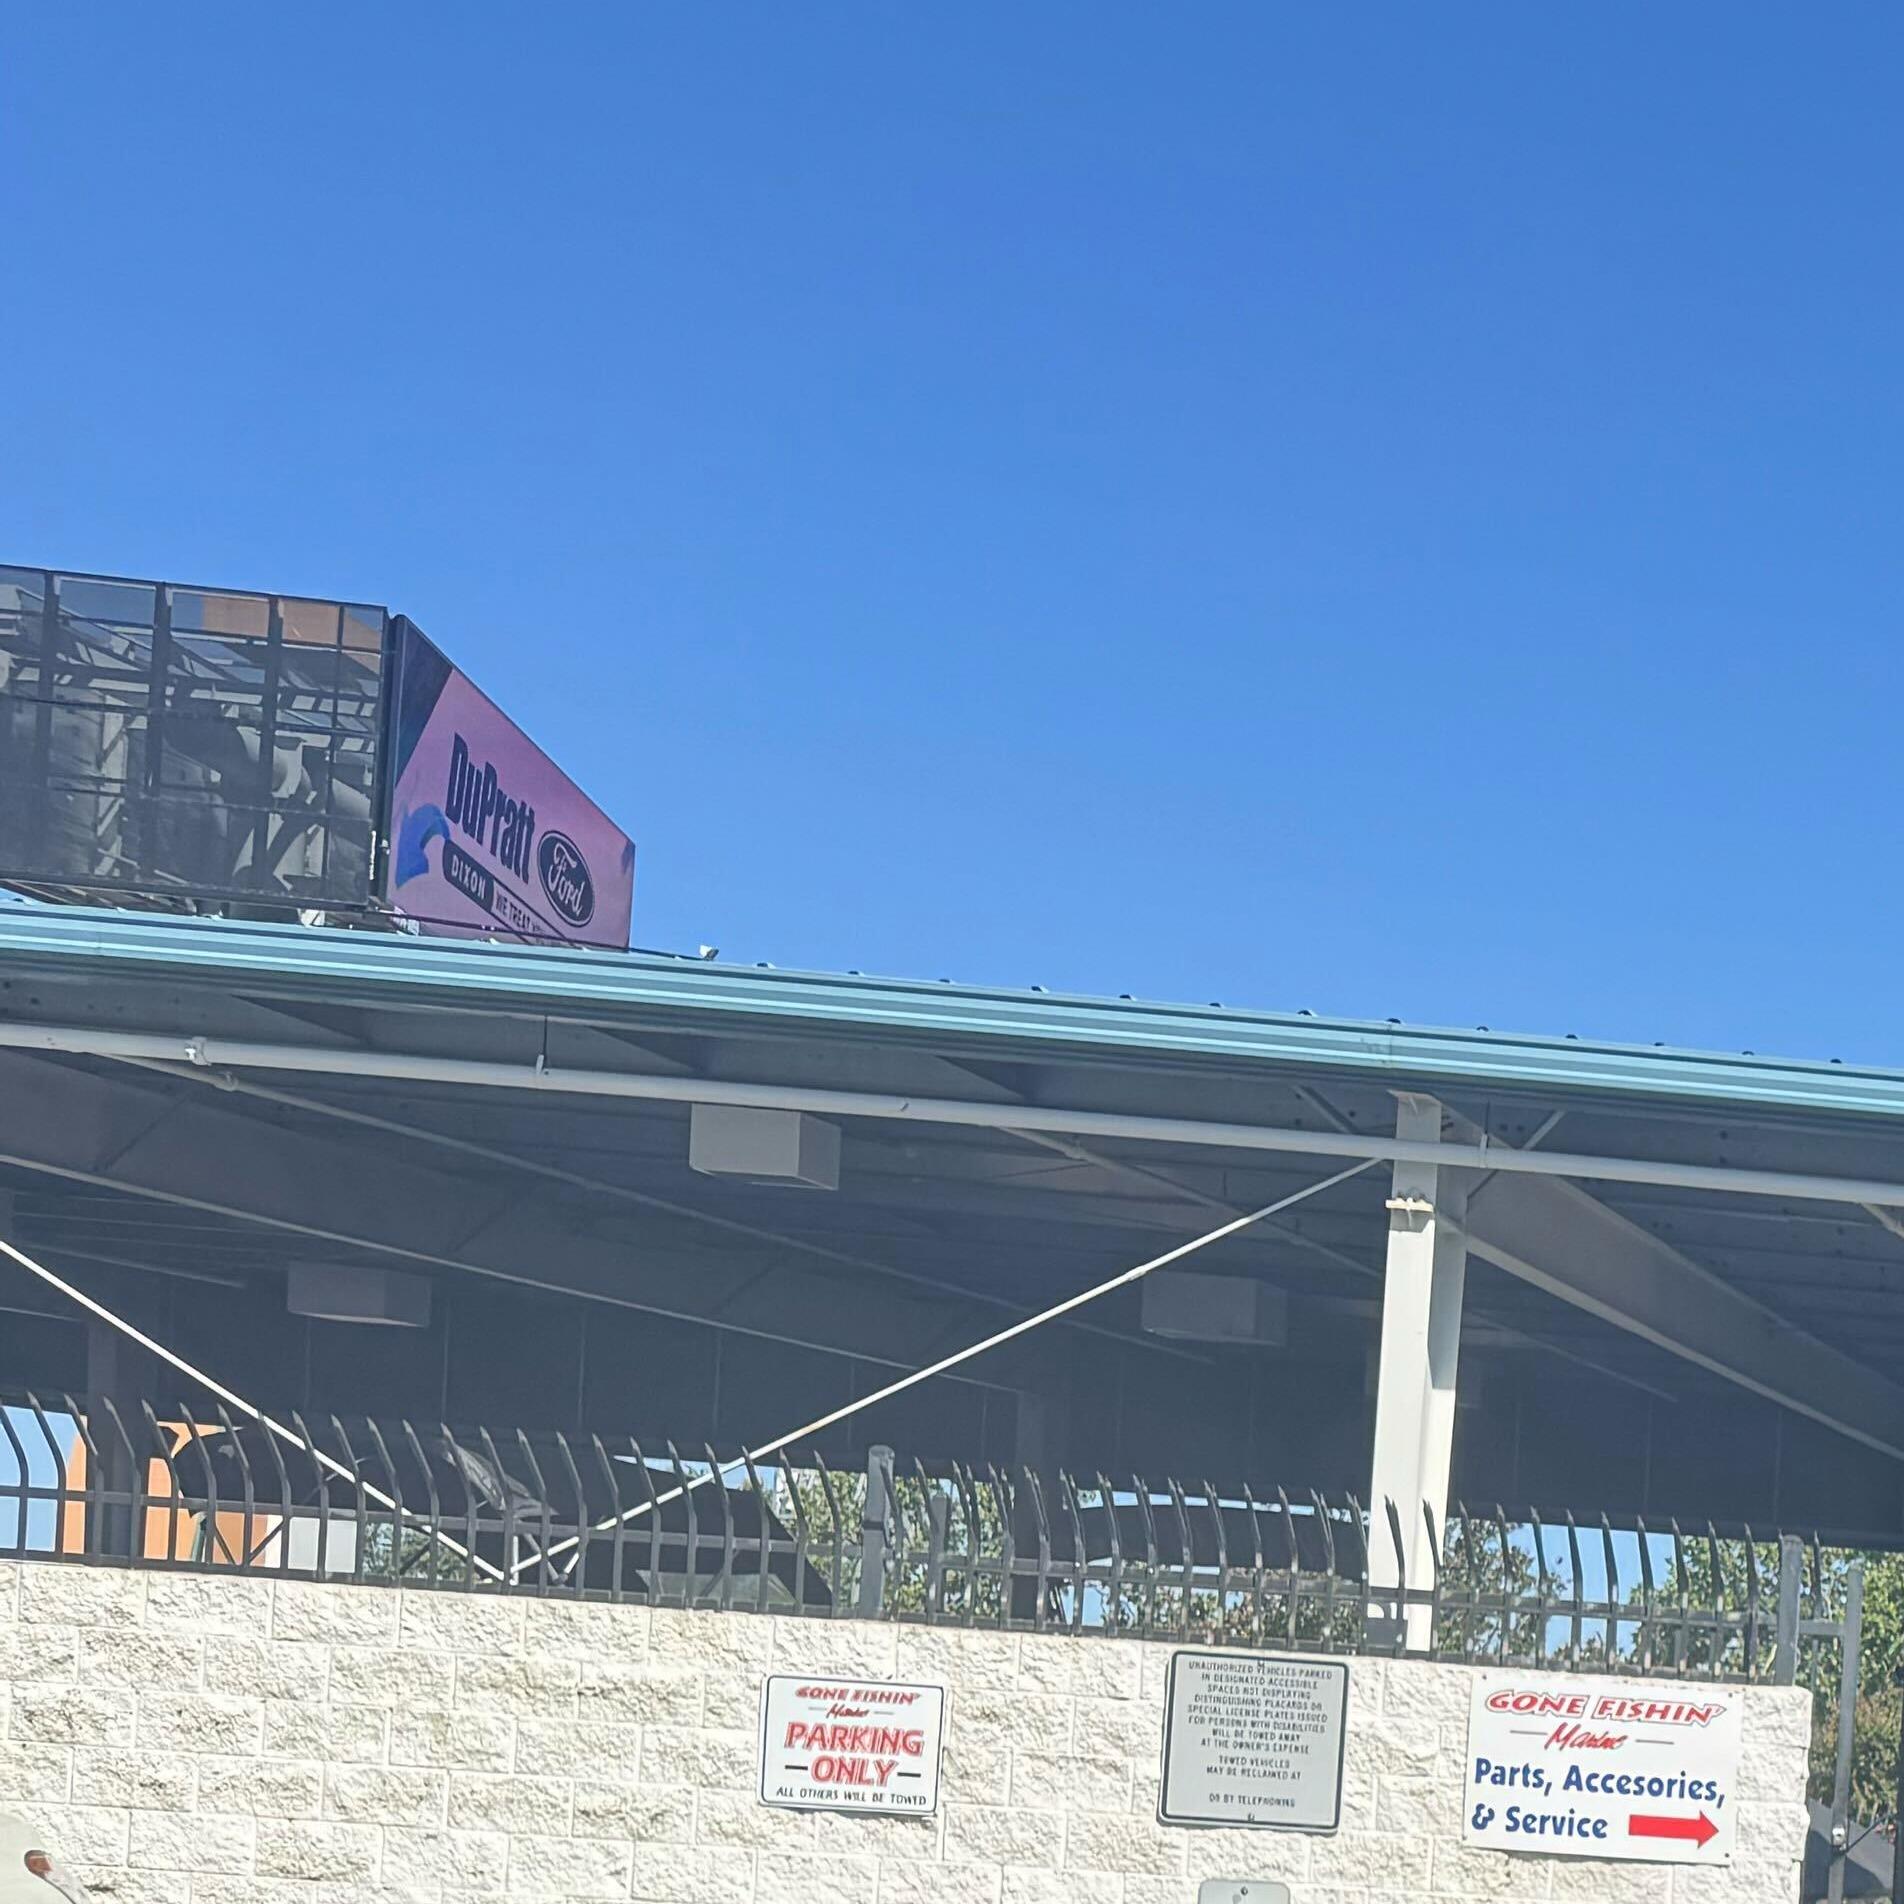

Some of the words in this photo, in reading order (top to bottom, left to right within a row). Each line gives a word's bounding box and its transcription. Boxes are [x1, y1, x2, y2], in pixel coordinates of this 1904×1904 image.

[446, 732, 535, 885] DuPratt
[451, 852, 486, 900] DIXON
[548, 843, 586, 917] Ford
[1189, 1661, 1253, 1673] UNAUTHORIZED
[1256, 1665, 1296, 1677] VEHICLES
[1299, 1668, 1332, 1680] PARKED
[1201, 1673, 1211, 1681] IN
[1214, 1674, 1265, 1685] DESIGNATED
[1268, 1678, 1318, 1690] ACCESSIBLE
[795, 1686, 847, 1701] GONE
[1207, 1684, 1240, 1694] SPACES
[1243, 1686, 1259, 1696] NOT
[1262, 1688, 1311, 1700] DISPLAYING
[1194, 1694, 1261, 1707] DISTINGUISHING
[1265, 1699, 1308, 1711] PLACARDS
[1487, 1690, 1589, 1717] GONE
[1187, 1704, 1222, 1715] SPECIAL
[1226, 1707, 1260, 1718] LICENSE
[1264, 1710, 1294, 1721] PLATES
[1297, 1712, 1328, 1723] ISSUED
[1188, 1715, 1206, 1725] FOR
[1208, 1716, 1247, 1728] PERSONS
[1251, 1719, 1270, 1729] WITH
[1273, 1721, 1325, 1733] DISABILITIES
[784, 1721, 924, 1757] PARKING
[1212, 1728, 1230, 1738] WILL
[1234, 1730, 1244, 1739] BE
[1249, 1731, 1276, 1741] TOWED
[1278, 1732, 1301, 1742] AWAY
[1544, 1722, 1629, 1750] Marine
[1201, 1738, 1210, 1747] AT
[1214, 1739, 1229, 1749] THE
[1273, 1742, 1309, 1754] EXPENSE
[811, 1755, 898, 1787] ONLY
[1219, 1755, 1247, 1766] TOWED
[1250, 1758, 1290, 1769] VEHICLES
[1206, 1766, 1223, 1775] MAY
[1226, 1767, 1237, 1776] BE
[1241, 1768, 1288, 1780] RECLAIMED
[1290, 1771, 1302, 1781] AT
[1475, 1758, 1552, 1796] Parts,
[1563, 1765, 1725, 1808] Accesories,
[776, 1786, 793, 1797] ALL
[800, 1788, 838, 1800] OTHERS
[844, 1791, 866, 1802] WILL
[872, 1793, 884, 1803] BE
[890, 1794, 927, 1806] TOWED
[1472, 1803, 1495, 1830] &
[1505, 1806, 1608, 1838] Service
